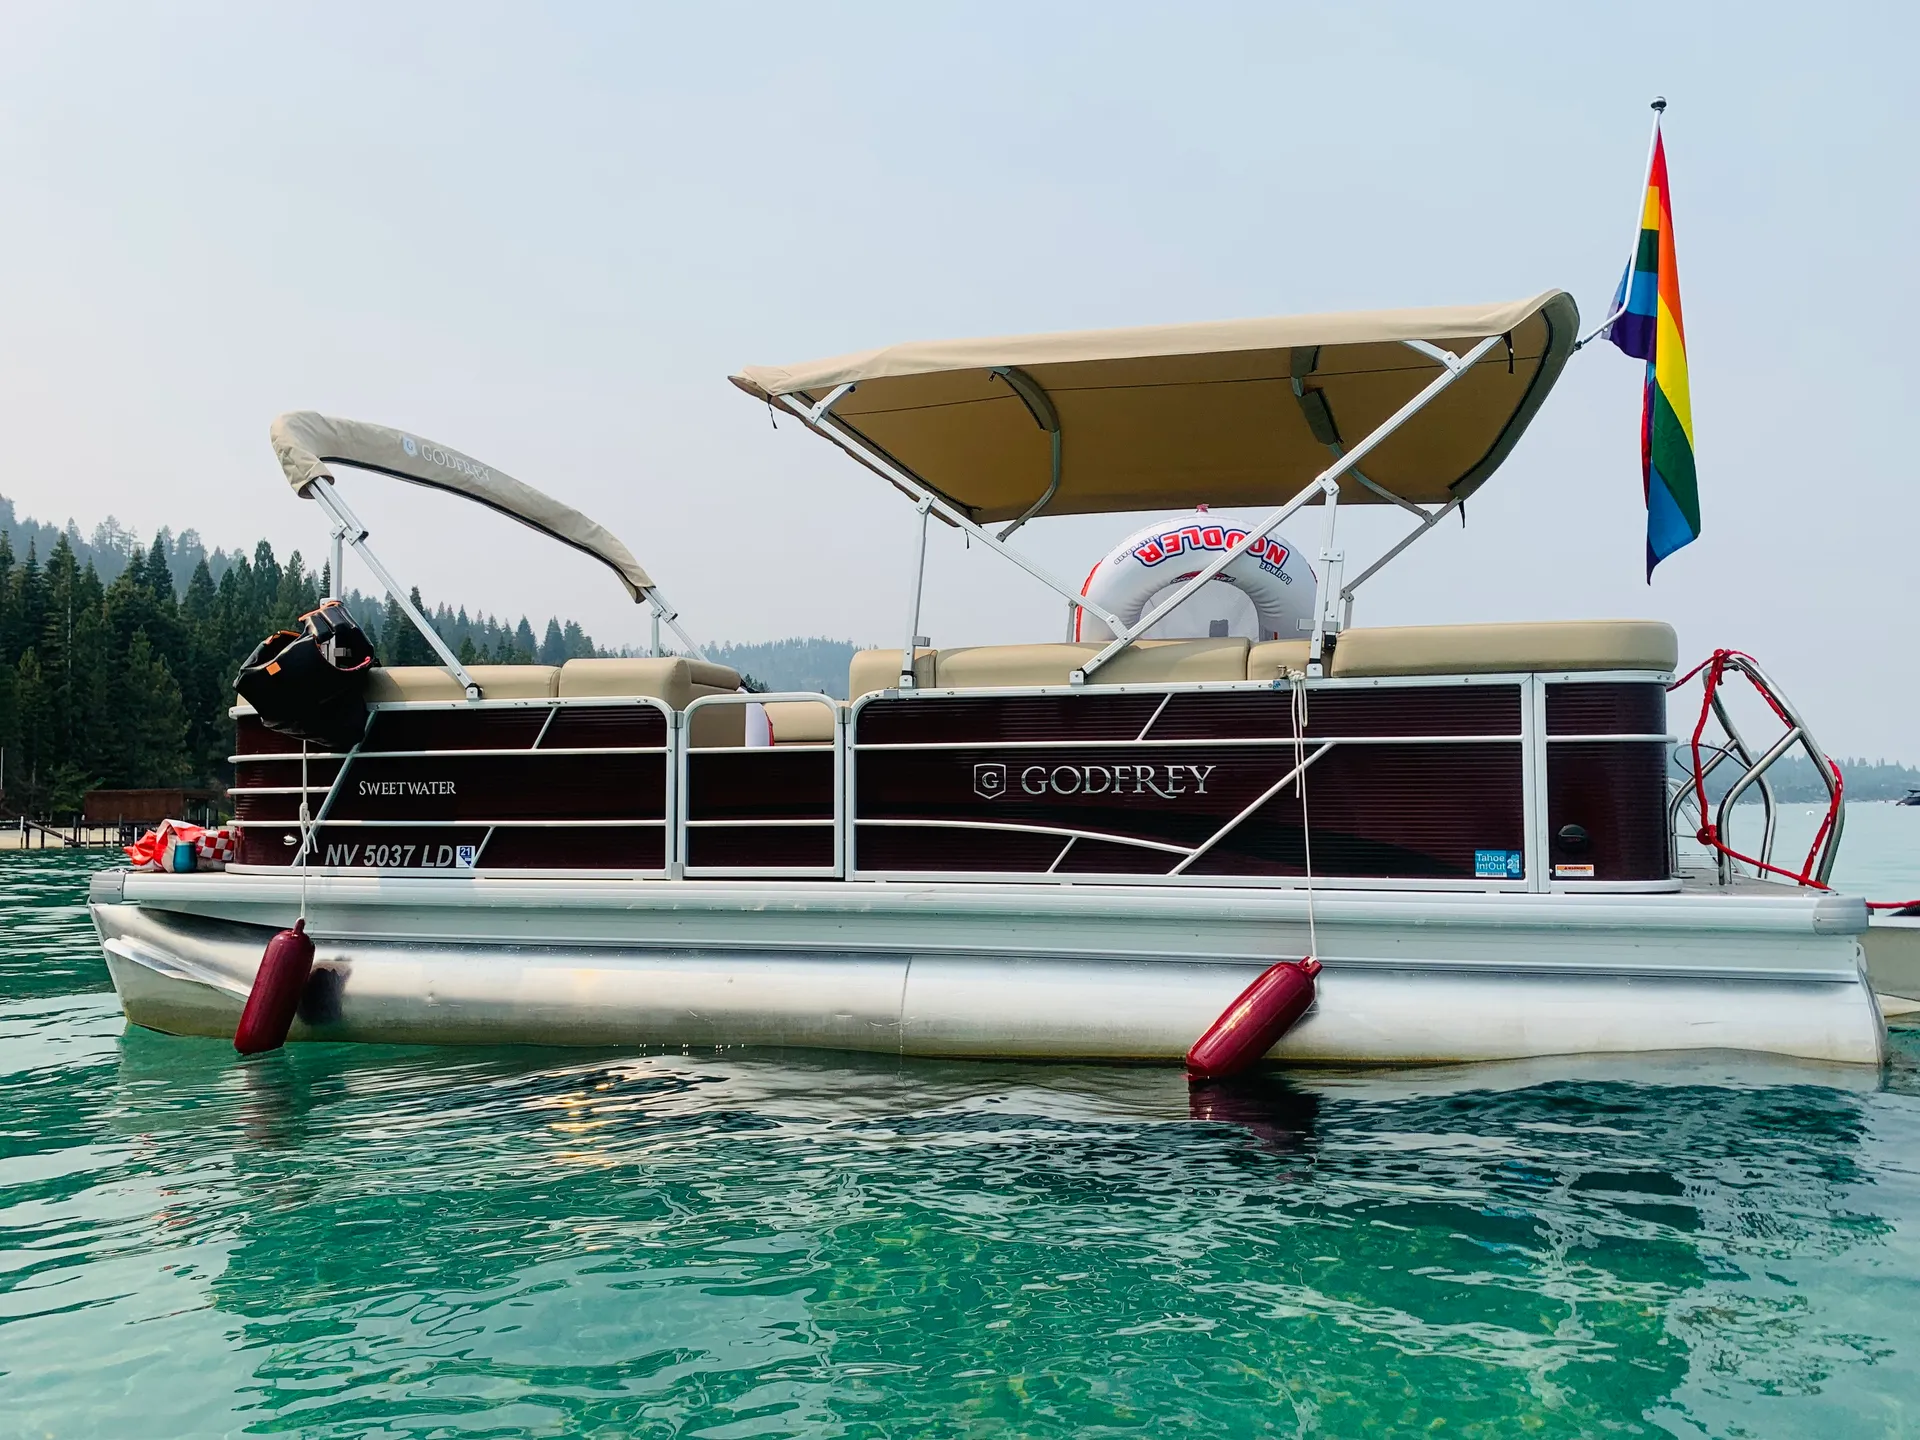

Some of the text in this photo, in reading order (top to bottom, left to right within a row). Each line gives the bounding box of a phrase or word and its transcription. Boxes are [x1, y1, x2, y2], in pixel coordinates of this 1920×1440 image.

[421, 444, 490, 481] GODFREY
[1259, 561, 1293, 585] LOUNGE
[1021, 765, 1217, 799] GODFREY
[325, 844, 454, 867] NV 5037 LD
[460, 847, 471, 856] 21
[1476, 853, 1505, 862] Tahoe
[1506, 858, 1520, 870] 21
